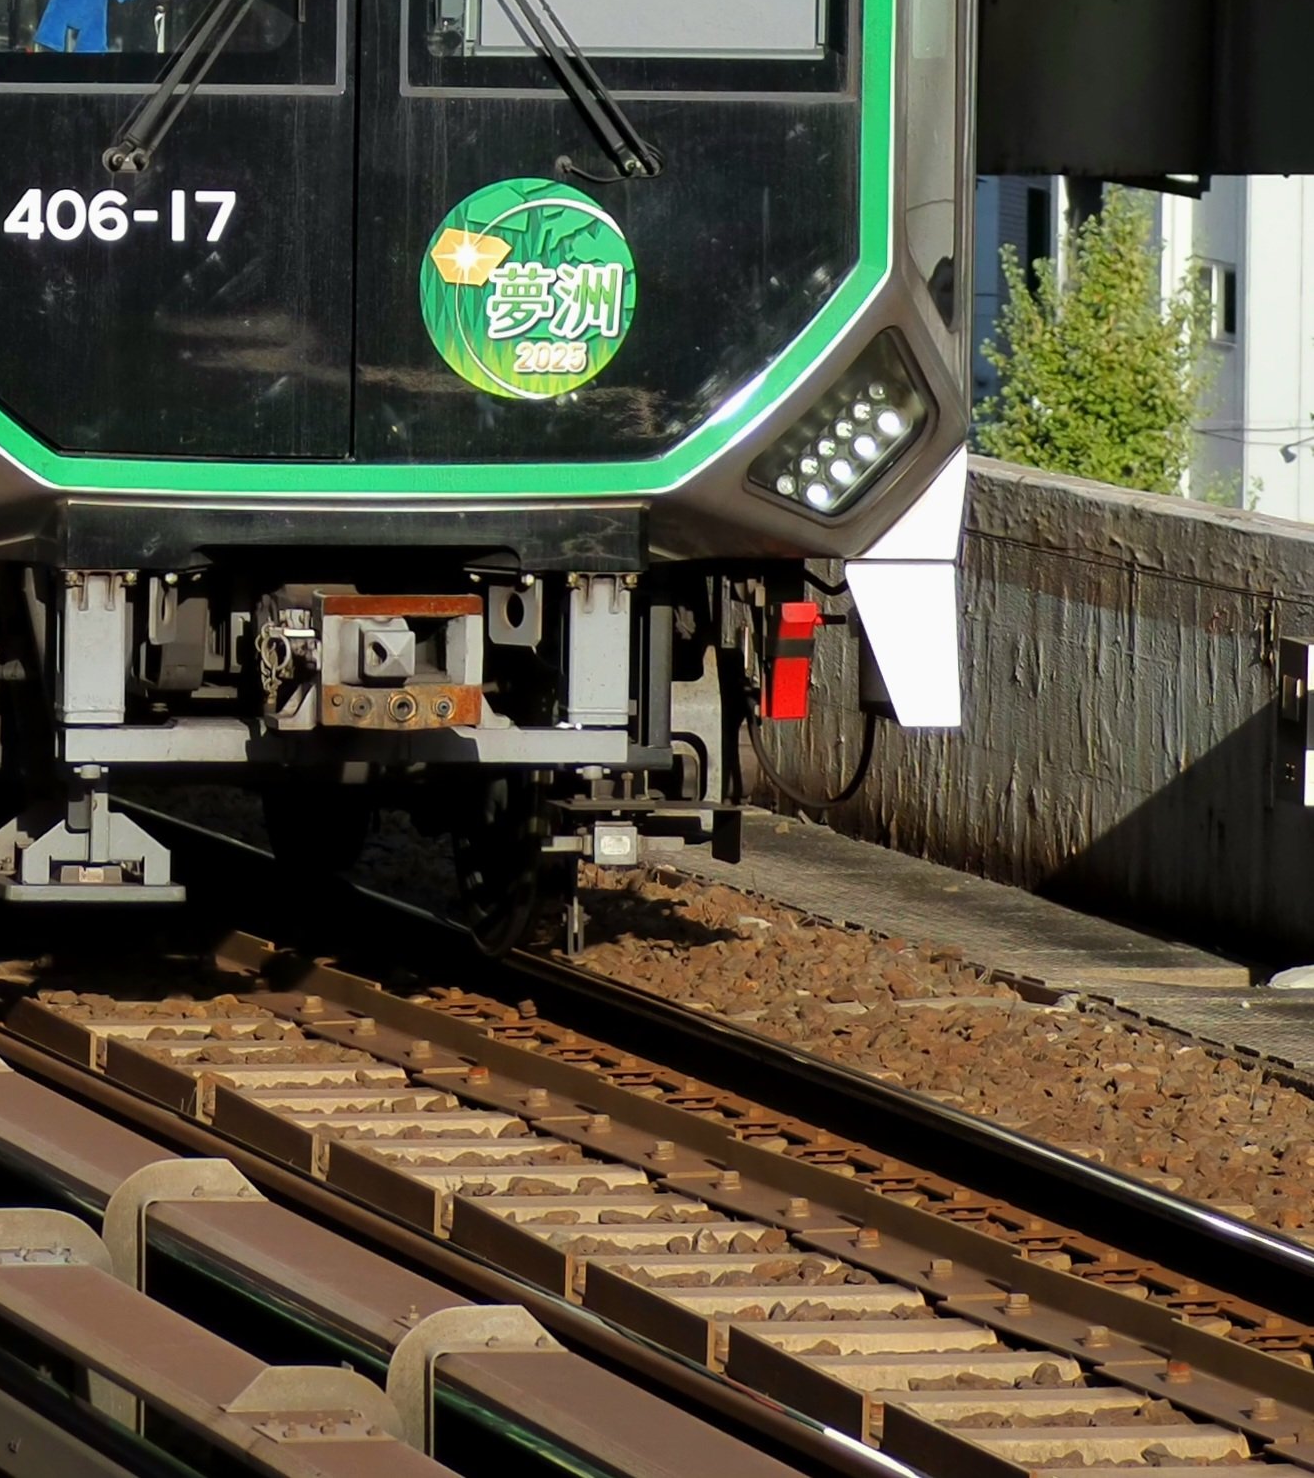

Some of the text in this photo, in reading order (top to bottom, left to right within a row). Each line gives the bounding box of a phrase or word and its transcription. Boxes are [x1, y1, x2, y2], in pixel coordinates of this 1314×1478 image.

[3, 188, 237, 242] 406-17
[486, 261, 624, 339] 夢洲
[514, 341, 588, 374] 2025
